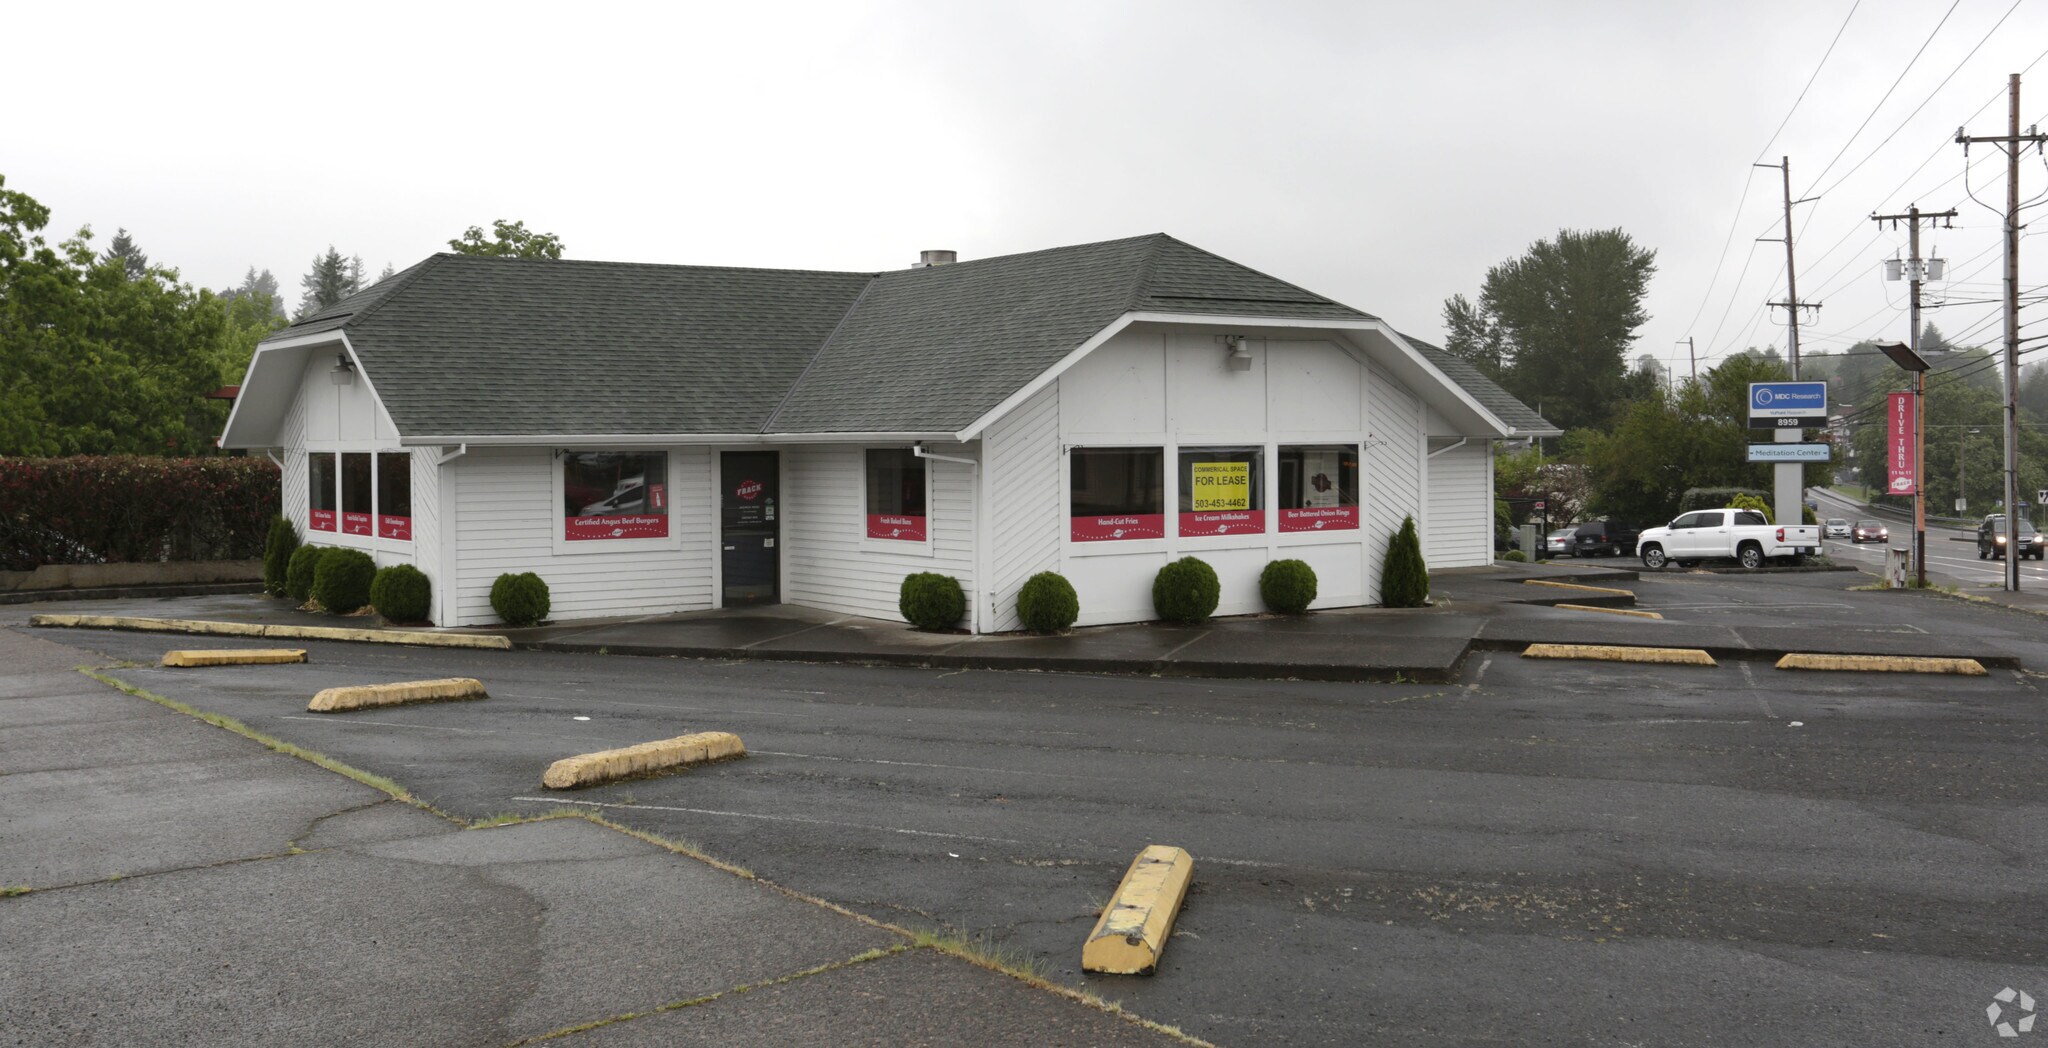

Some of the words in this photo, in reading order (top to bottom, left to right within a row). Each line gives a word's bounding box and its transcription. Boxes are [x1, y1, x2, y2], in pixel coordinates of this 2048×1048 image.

[1777, 418, 1799, 426] 8959
[1195, 476, 1215, 486] FOR
[1216, 475, 1246, 485] LEASE
[1195, 498, 1246, 508] 503-453-4462
[1220, 513, 1249, 521] Milkshakes
[1336, 509, 1350, 517] Rings
[635, 517, 659, 525] Burgers
[1098, 518, 1125, 526] Hand-Cut
